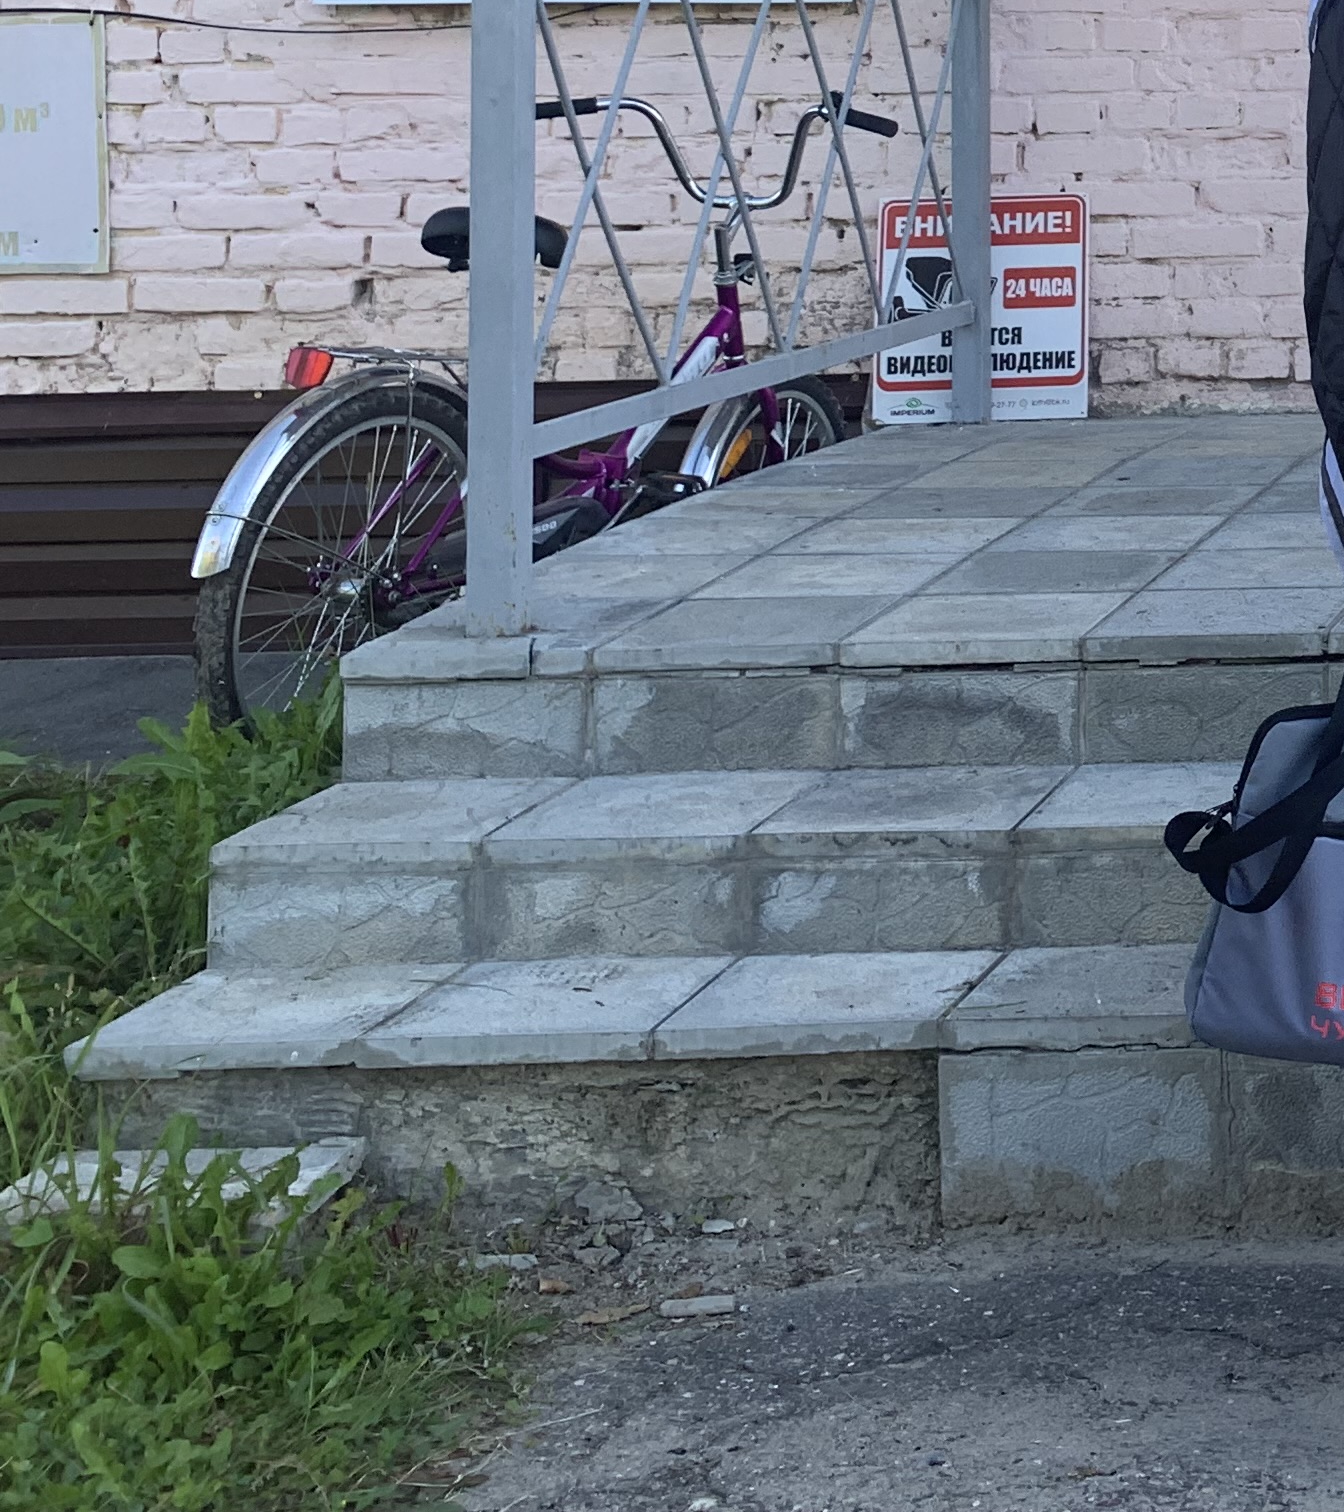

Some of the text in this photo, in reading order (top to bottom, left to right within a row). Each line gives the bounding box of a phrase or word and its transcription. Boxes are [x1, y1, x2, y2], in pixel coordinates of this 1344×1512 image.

[1006, 276, 1074, 298] 24 ЧАСА
[940, 326, 1023, 348] ВТСЯ
[890, 409, 935, 417] IMPERIUM
